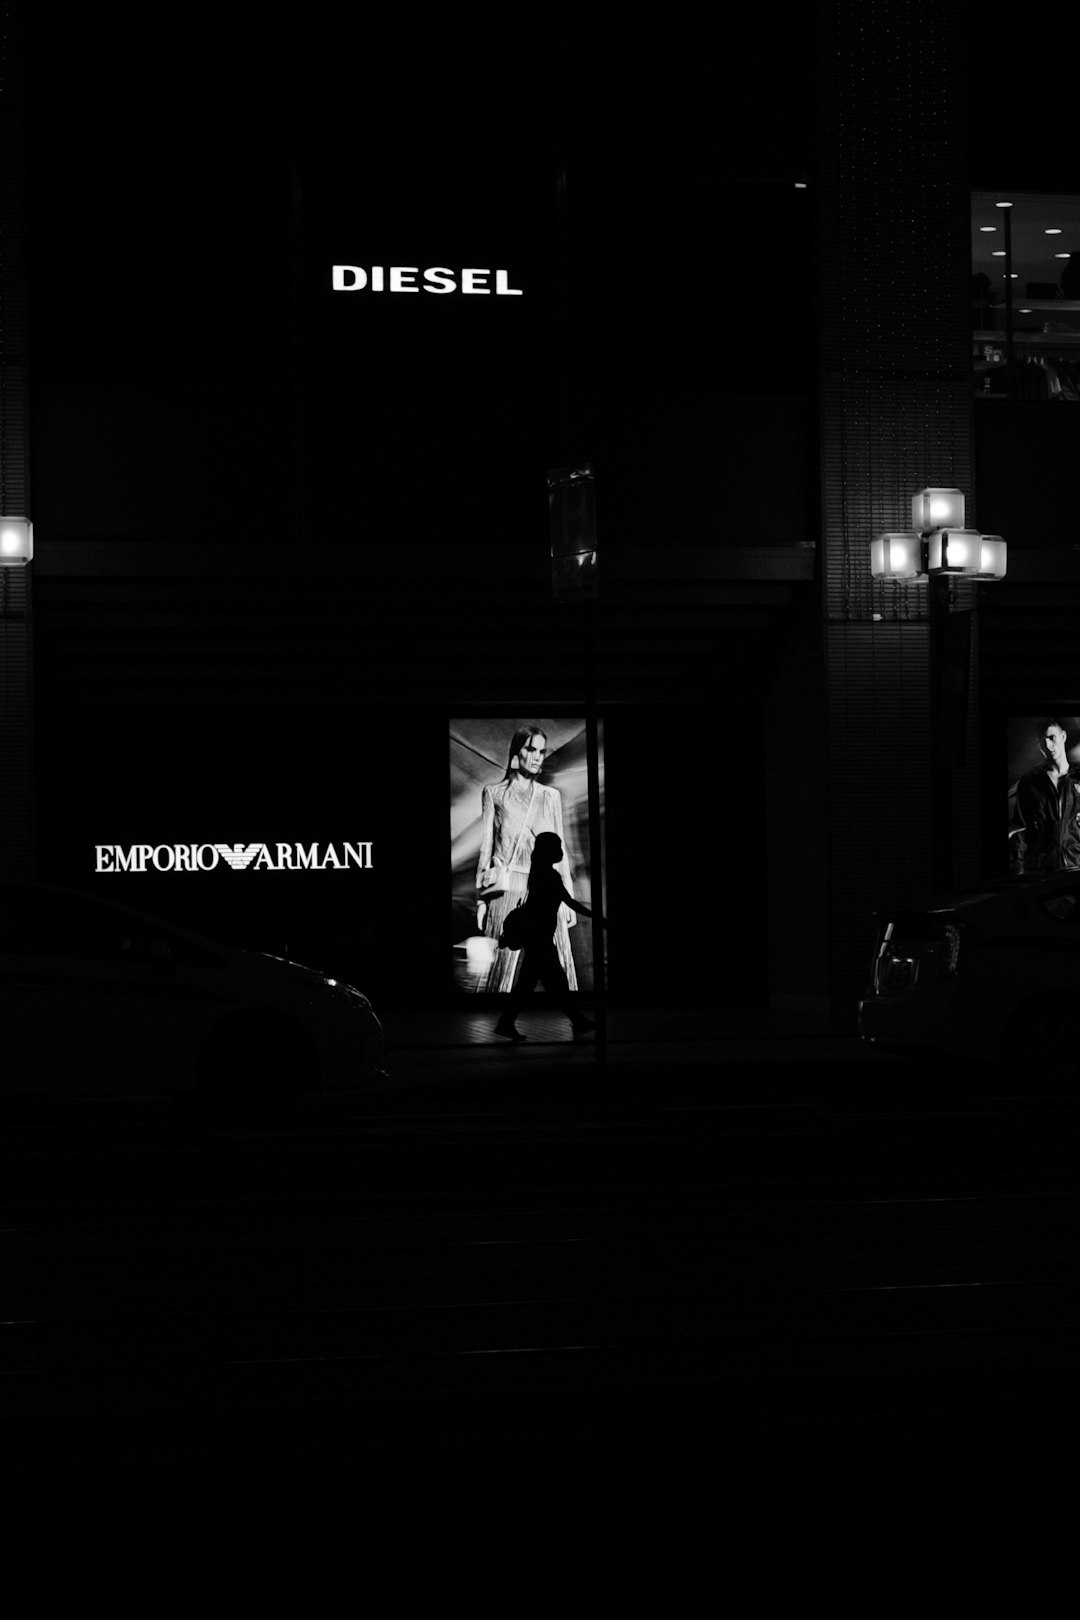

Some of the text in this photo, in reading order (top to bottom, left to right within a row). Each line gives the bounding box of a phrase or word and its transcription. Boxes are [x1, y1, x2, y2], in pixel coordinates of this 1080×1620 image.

[332, 265, 523, 295] DIESEL
[95, 842, 373, 872] EMPORIO ARMANI
